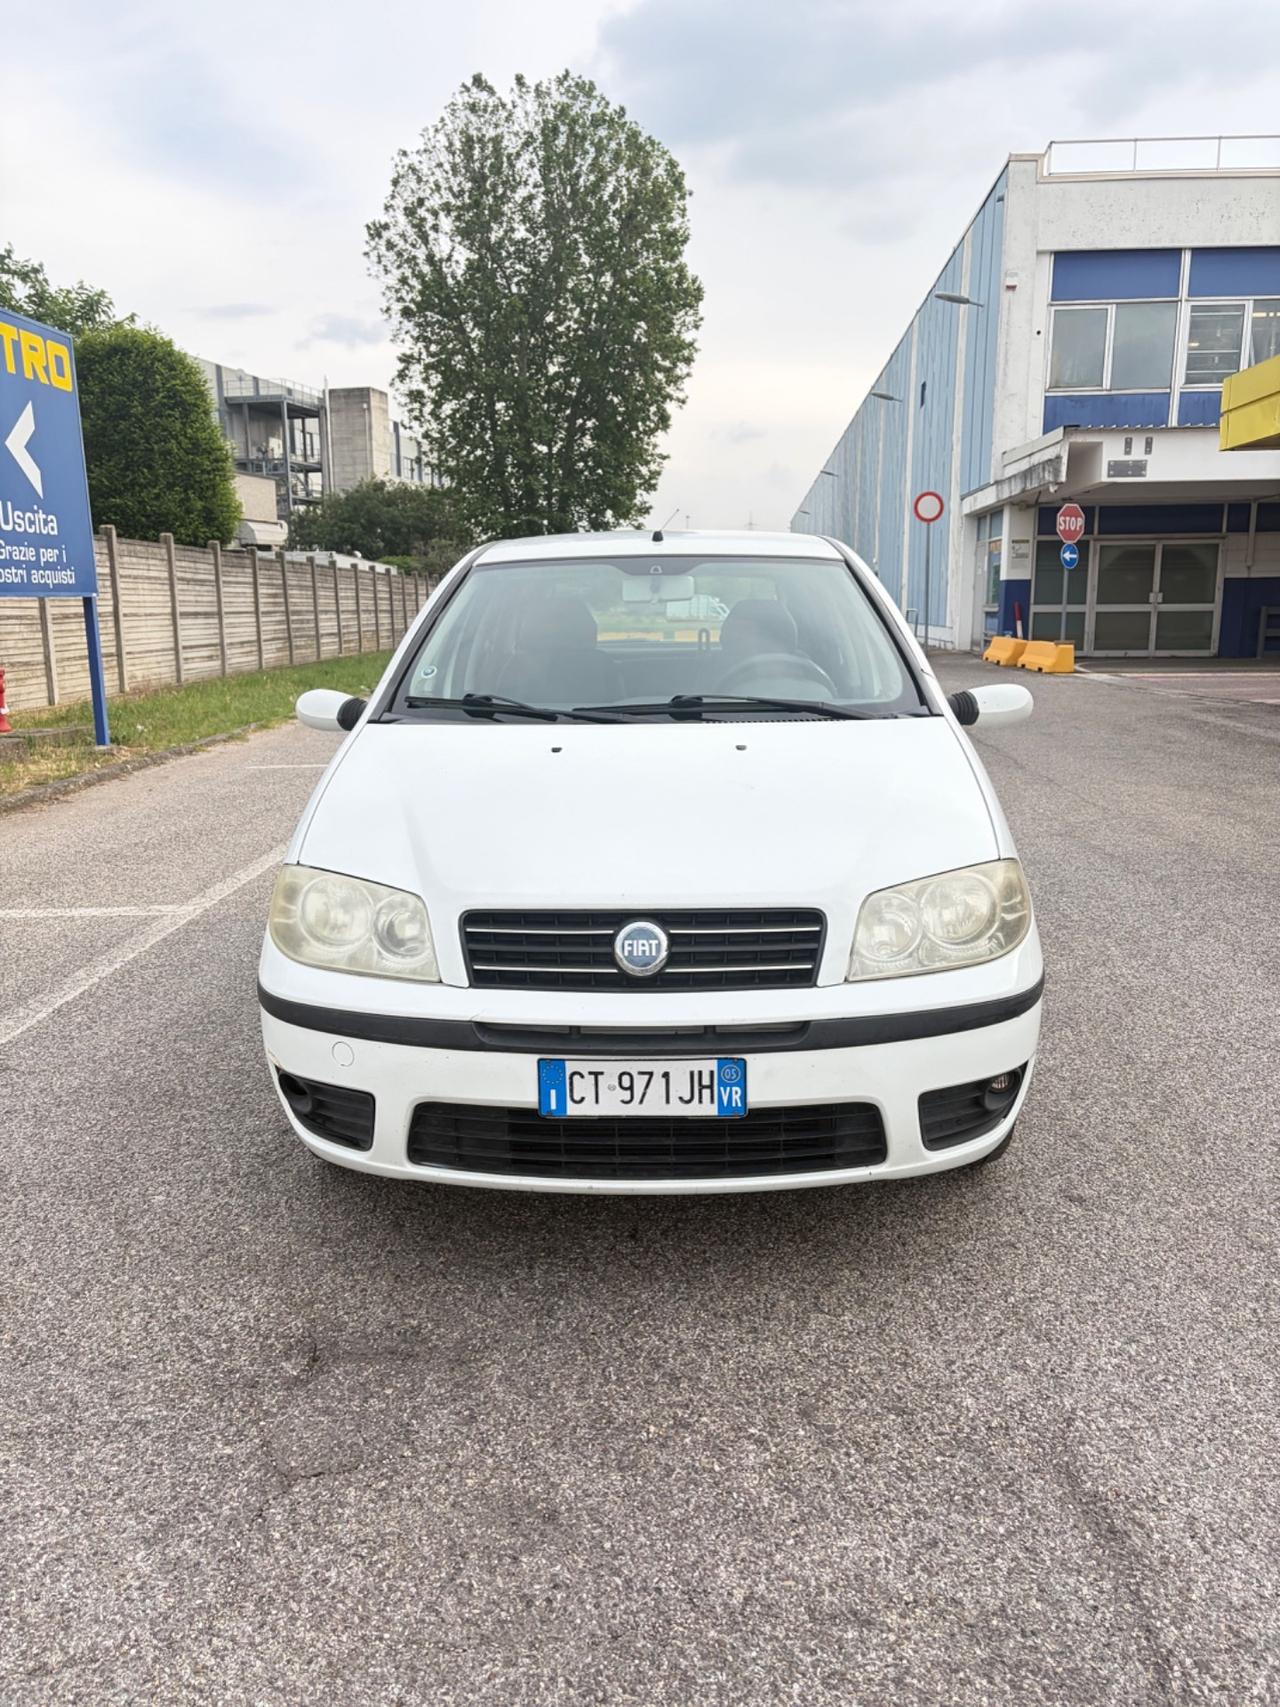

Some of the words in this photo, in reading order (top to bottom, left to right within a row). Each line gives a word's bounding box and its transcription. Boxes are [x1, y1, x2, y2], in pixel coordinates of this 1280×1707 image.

[0, 321, 73, 392] TRO
[0, 501, 58, 535] Uscita
[1059, 516, 1082, 531] STOP
[0, 539, 36, 561] Grazie
[40, 546, 59, 567] per
[62, 544, 67, 563] i
[31, 565, 76, 589] acquisti
[623, 939, 659, 957] FIAT
[724, 1068, 737, 1080] 05
[550, 1088, 557, 1110] I
[719, 1086, 741, 1107] VR
